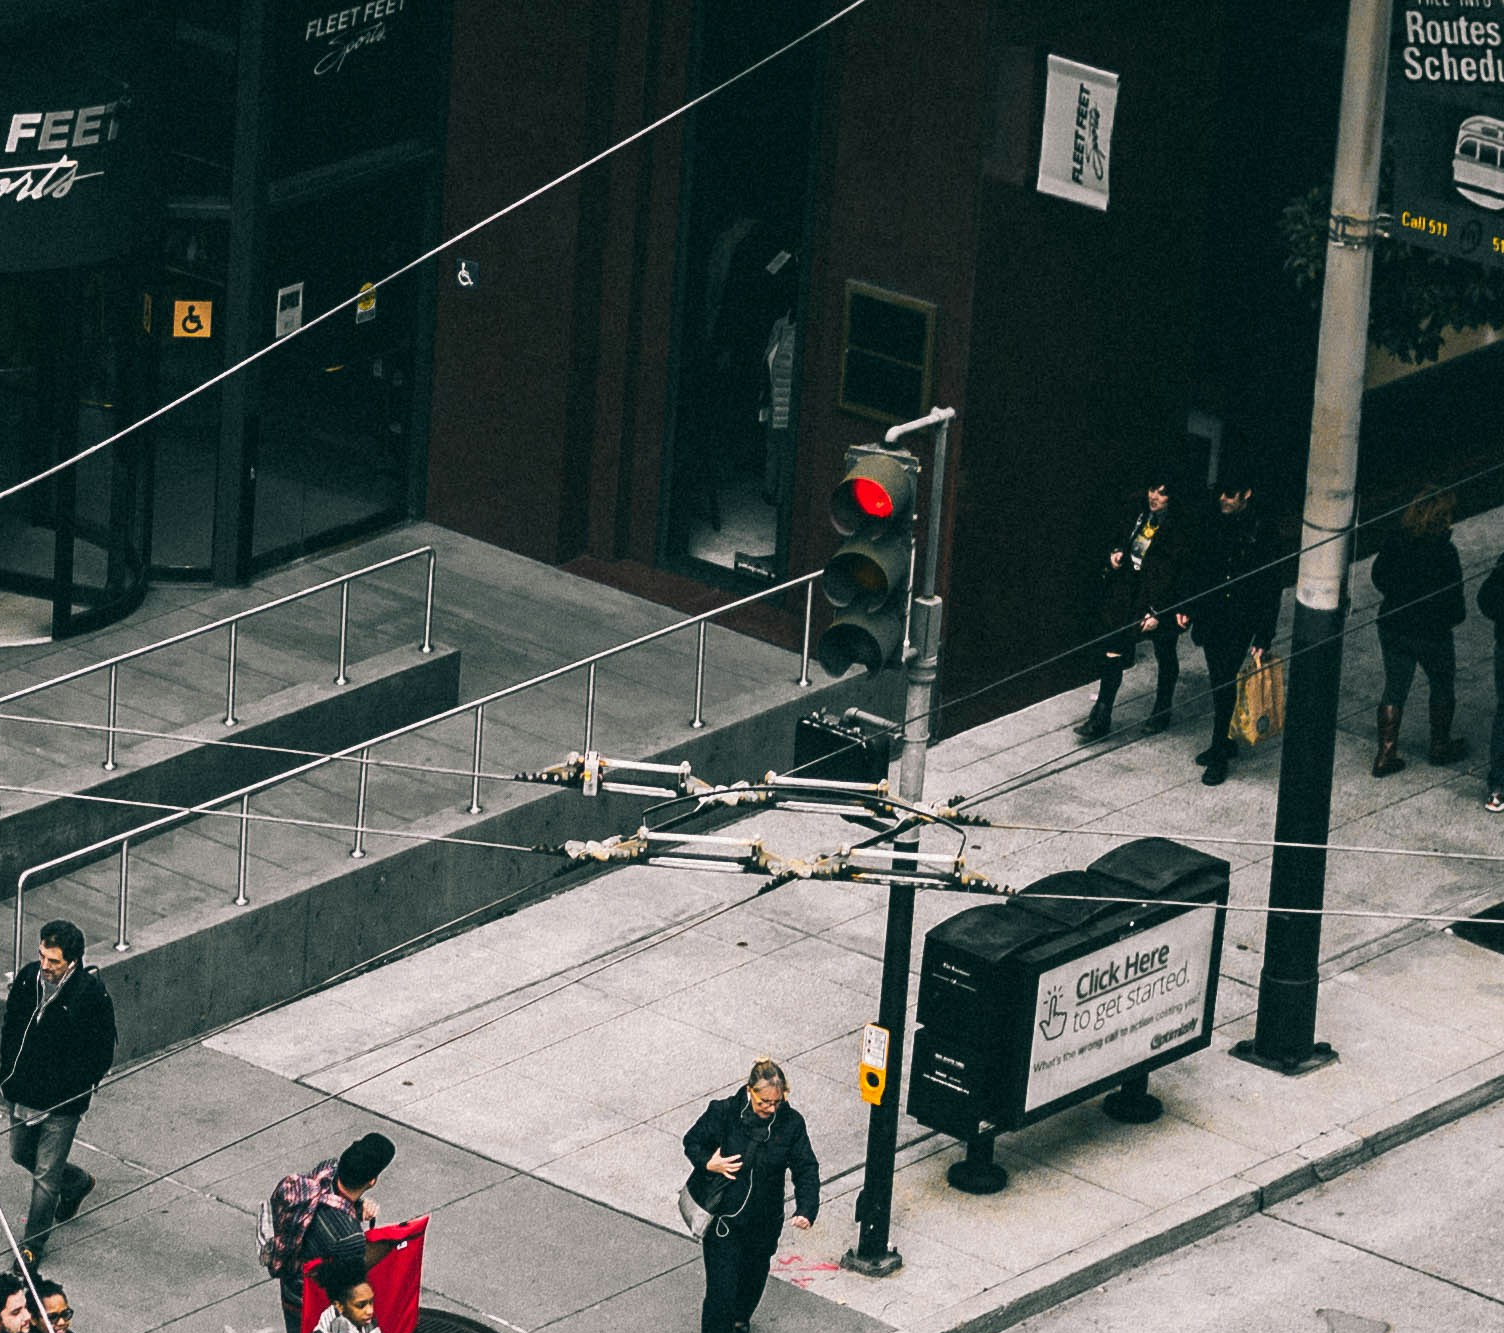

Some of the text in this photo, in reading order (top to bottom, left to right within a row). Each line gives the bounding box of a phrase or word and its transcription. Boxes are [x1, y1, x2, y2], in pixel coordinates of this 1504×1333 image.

[304, 5, 362, 42] FLEET
[1405, 10, 1502, 46] Routes
[1071, 82, 1091, 185] FLEET FEET
[1401, 210, 1449, 237] Call 511
[1073, 959, 1190, 1033] to get started.
[1075, 944, 1170, 1000] Click Here
[1033, 1055, 1062, 1073] What's
[1063, 1049, 1077, 1061] the
[1077, 1038, 1103, 1056] wrong
[1104, 1029, 1119, 1045] call
[1129, 1016, 1154, 1034] action
